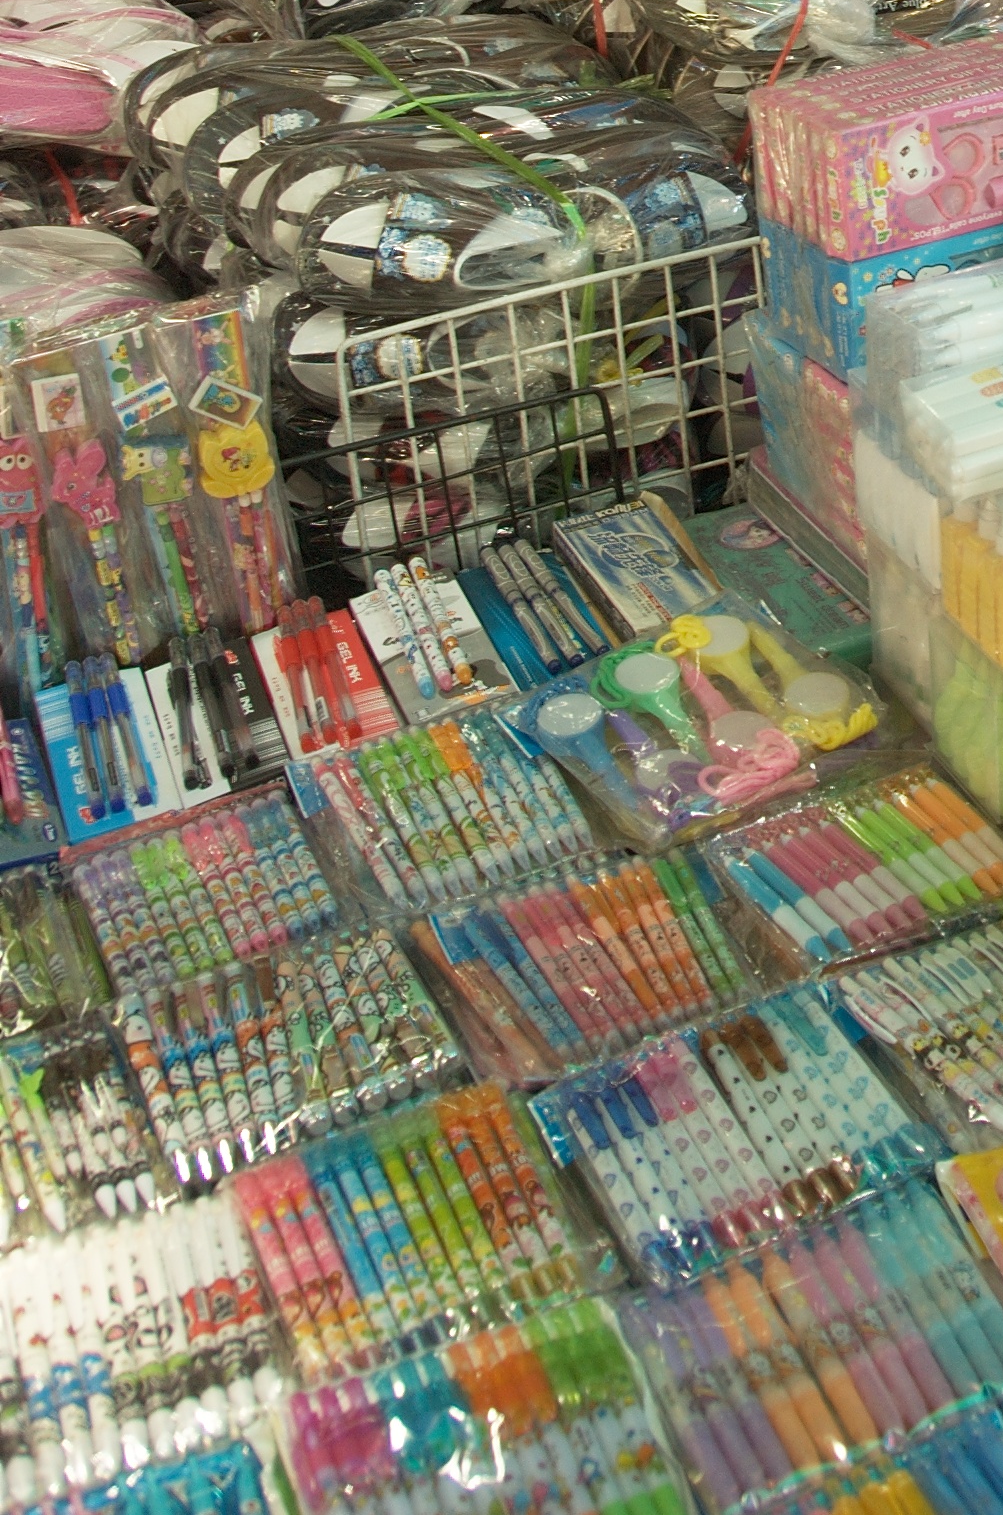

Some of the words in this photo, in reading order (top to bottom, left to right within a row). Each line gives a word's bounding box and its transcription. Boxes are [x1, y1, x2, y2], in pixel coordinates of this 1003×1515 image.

[878, 1, 899, 12] Art
[850, 75, 948, 104] STATIONERY
[951, 67, 983, 80] GIFT
[953, 108, 972, 119] after
[968, 210, 1003, 225] everyone
[335, 641, 350, 664] GEL
[346, 664, 364, 685] INK
[239, 697, 256, 716] INK
[66, 746, 84, 768] INK
